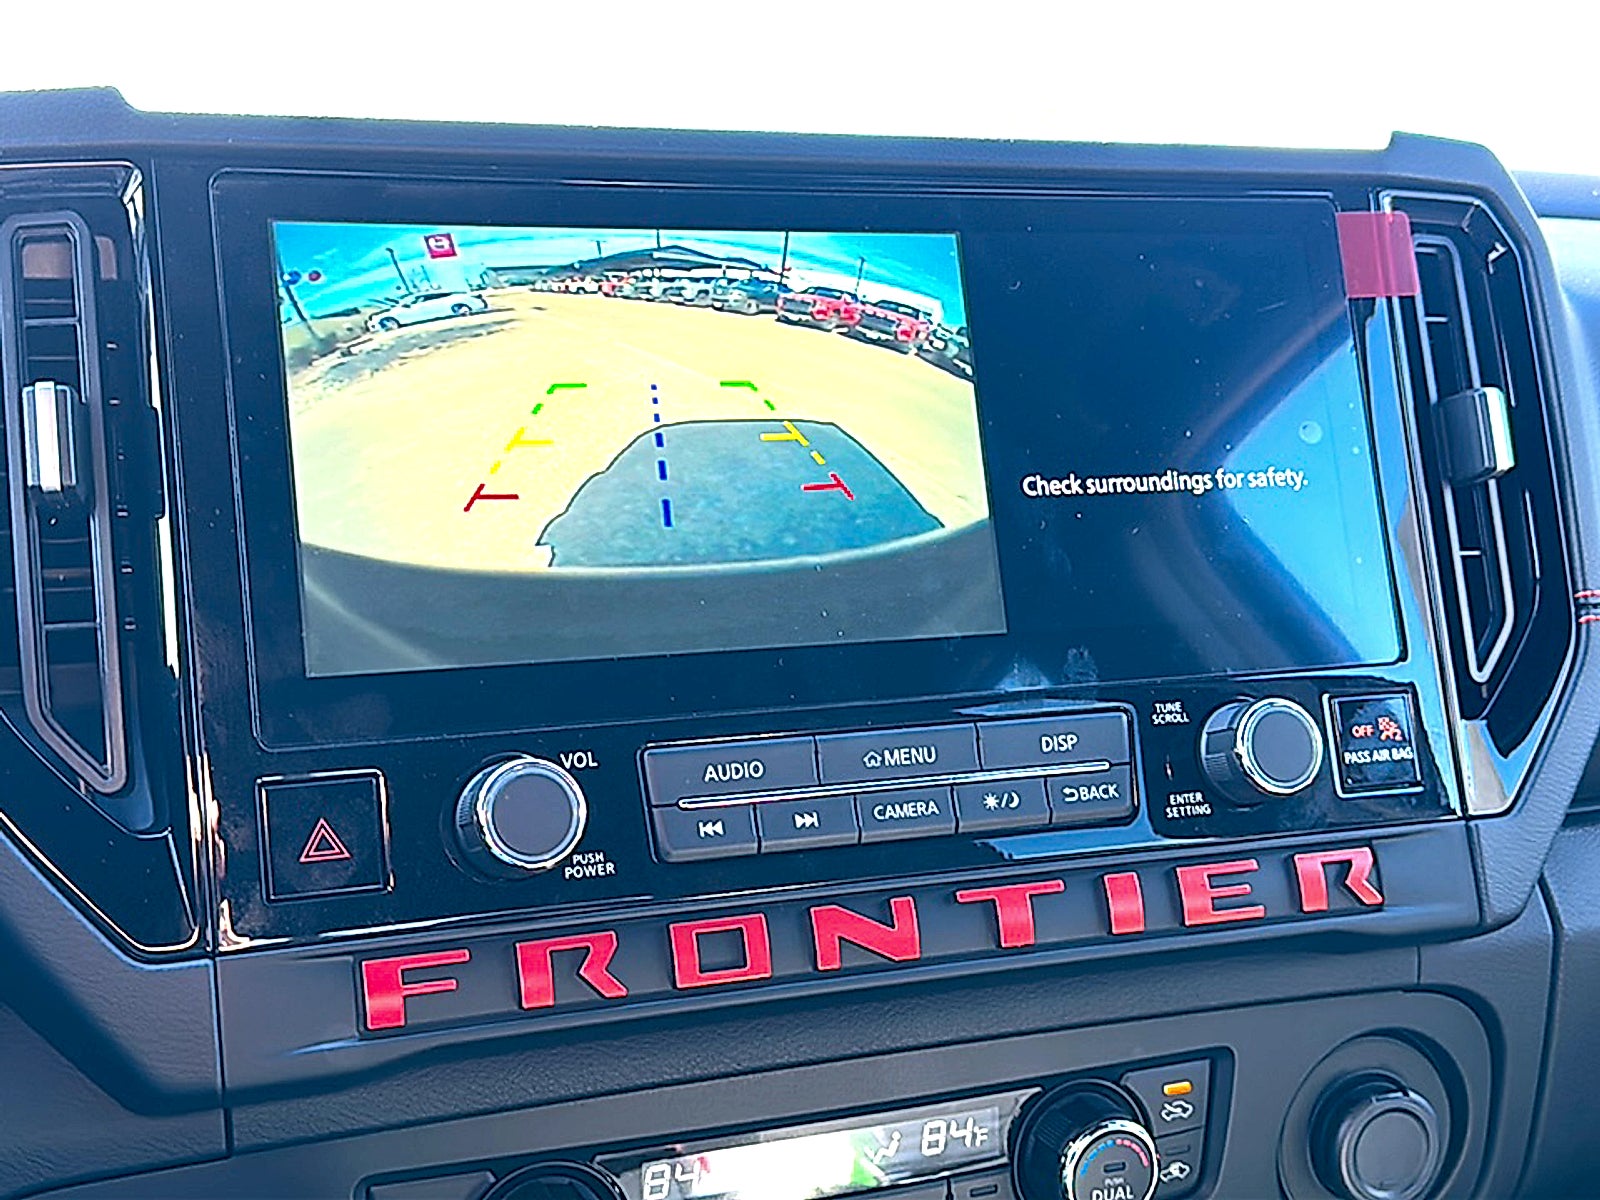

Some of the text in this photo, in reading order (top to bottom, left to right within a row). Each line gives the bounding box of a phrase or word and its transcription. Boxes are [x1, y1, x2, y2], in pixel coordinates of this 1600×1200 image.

[1022, 466, 1309, 497] Check surroundings for safety.
[1154, 701, 1183, 713] TUNE
[1151, 712, 1190, 725] SCROLL
[1351, 724, 1375, 738] OFF
[1041, 734, 1079, 753] DISP
[559, 751, 598, 770] VOL
[883, 745, 937, 767] MENU
[1343, 746, 1414, 765] PASS AIR BAG
[703, 760, 765, 783] AUDIO
[1078, 783, 1120, 802] BACK
[1169, 791, 1204, 805] ENTER
[872, 800, 940, 821] CAMERA
[1165, 803, 1212, 818] SETTING
[572, 852, 605, 865] PUSH
[564, 862, 616, 880] POWER
[360, 847, 1386, 1032] FRONTIER
[1091, 1186, 1134, 1200] DUAL
